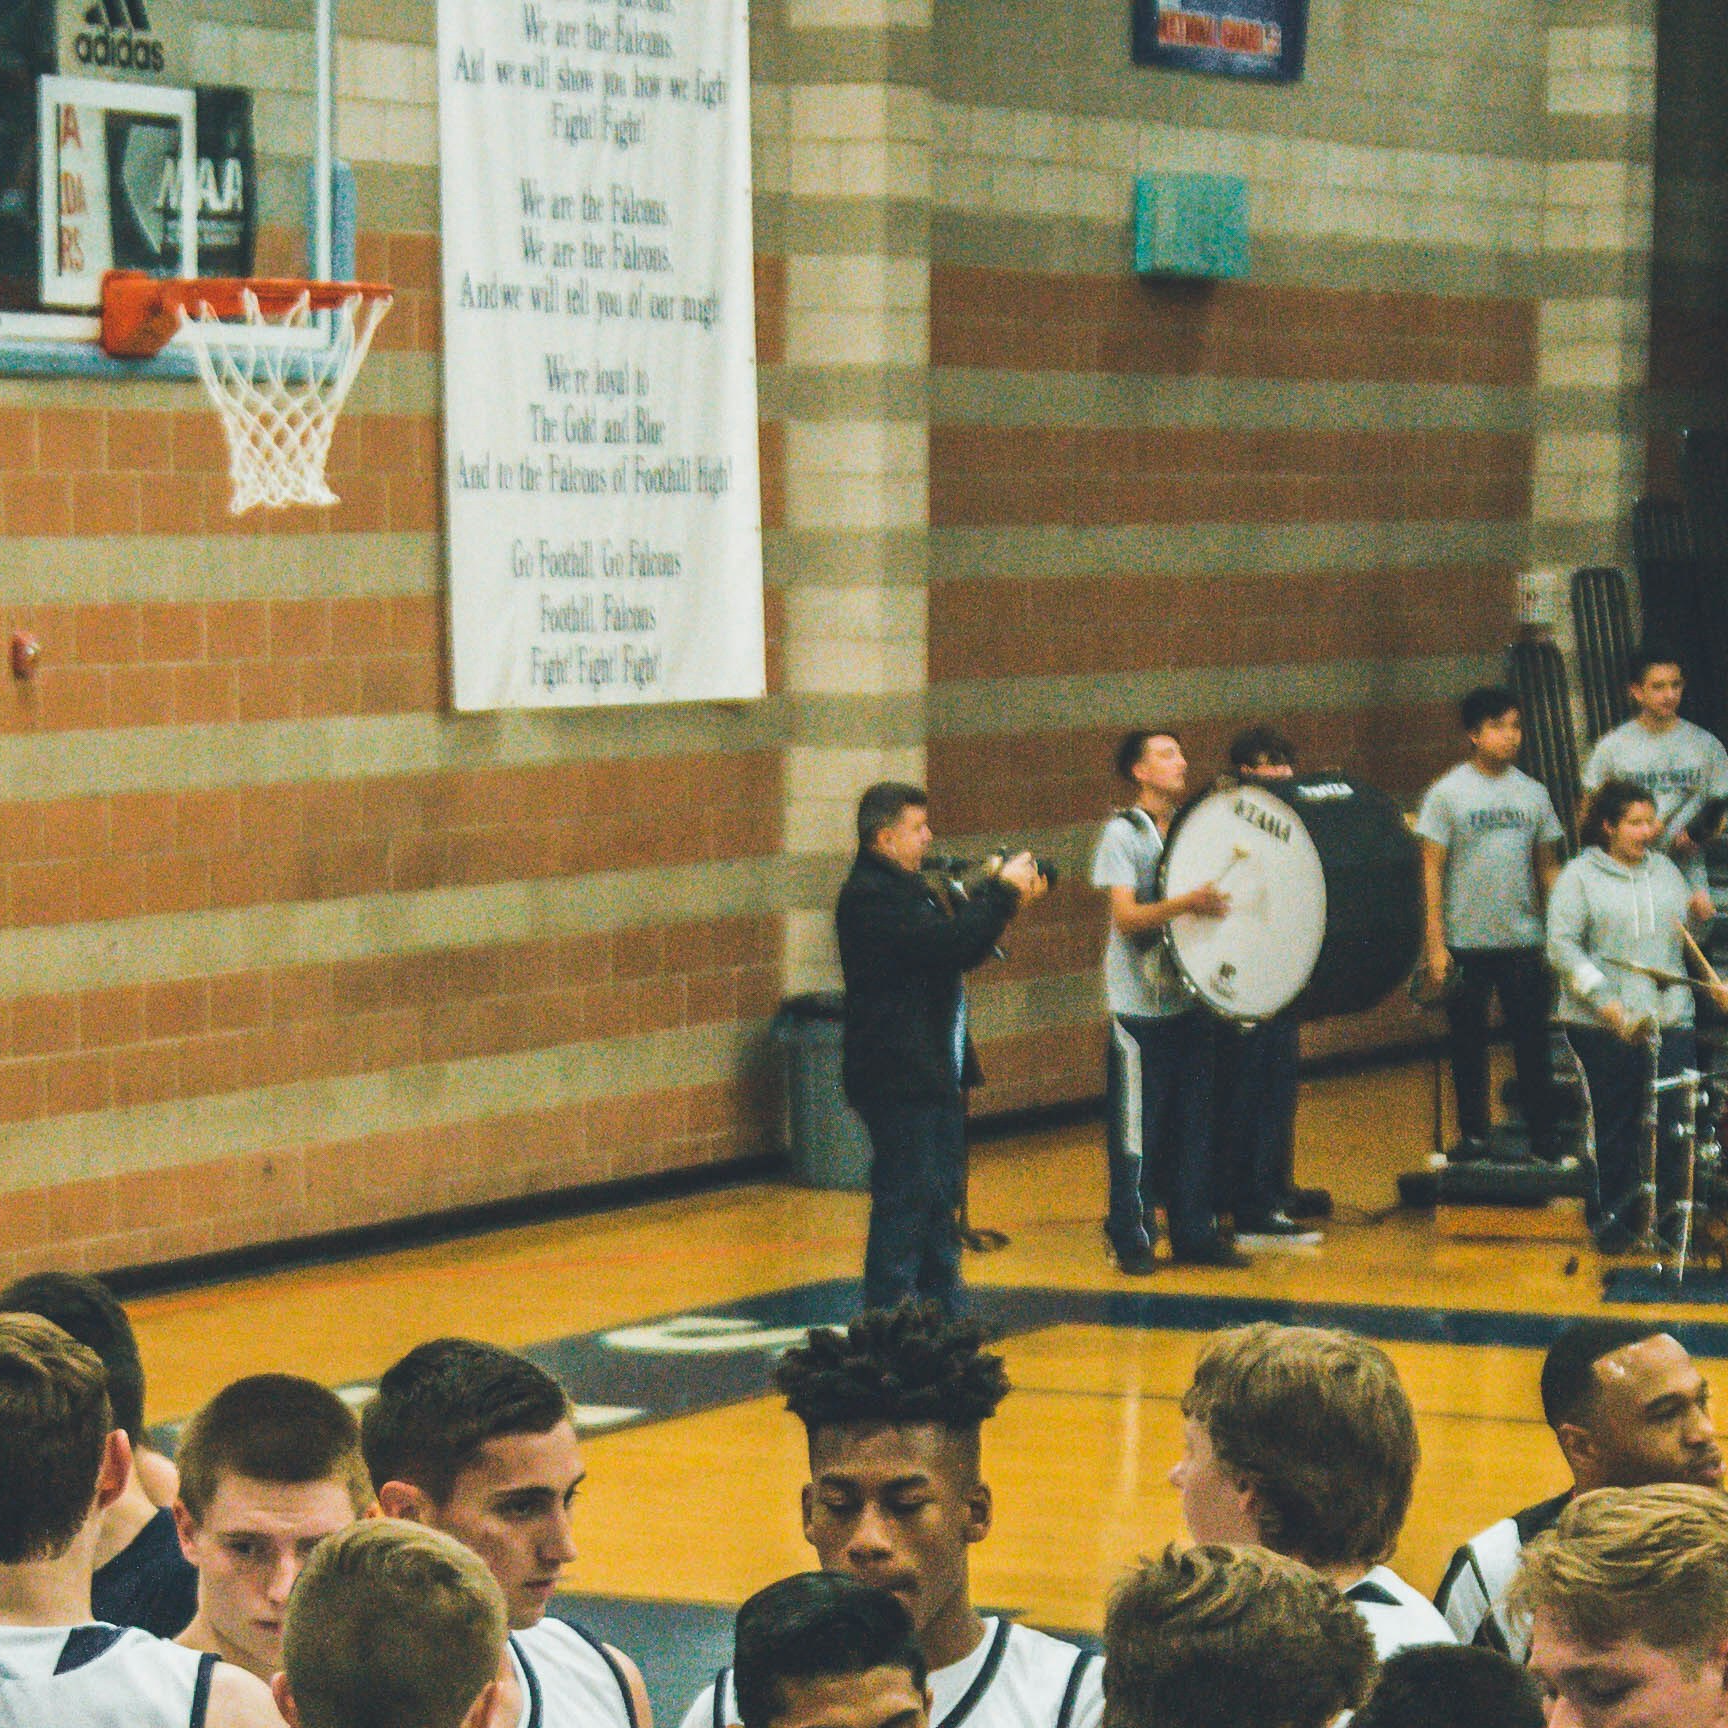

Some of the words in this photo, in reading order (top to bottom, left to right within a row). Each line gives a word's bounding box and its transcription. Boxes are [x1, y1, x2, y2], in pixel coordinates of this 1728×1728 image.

[74, 30, 165, 73] adidas
[585, 14, 610, 51] the
[156, 157, 244, 212] NAA
[520, 177, 544, 219] We
[551, 193, 575, 220] are
[582, 182, 604, 222] the
[520, 226, 545, 266] We
[552, 239, 576, 267] are
[583, 231, 606, 269] the
[530, 275, 560, 314] will
[566, 278, 589, 315] tell
[628, 281, 644, 319] of
[595, 356, 629, 402] loyal
[635, 366, 650, 396] to
[529, 404, 558, 443] The
[564, 404, 597, 443] Gold
[604, 406, 629, 443] and
[635, 405, 666, 444] Blue
[458, 450, 490, 489] And
[497, 460, 513, 489] to
[519, 455, 542, 491] the
[549, 453, 607, 493] Falcons
[613, 454, 628, 493] of
[634, 454, 690, 493] Foothill
[511, 538, 533, 578] Go
[602, 538, 623, 578] Go
[628, 539, 683, 578] Falcons
[603, 592, 657, 632] Falcons
